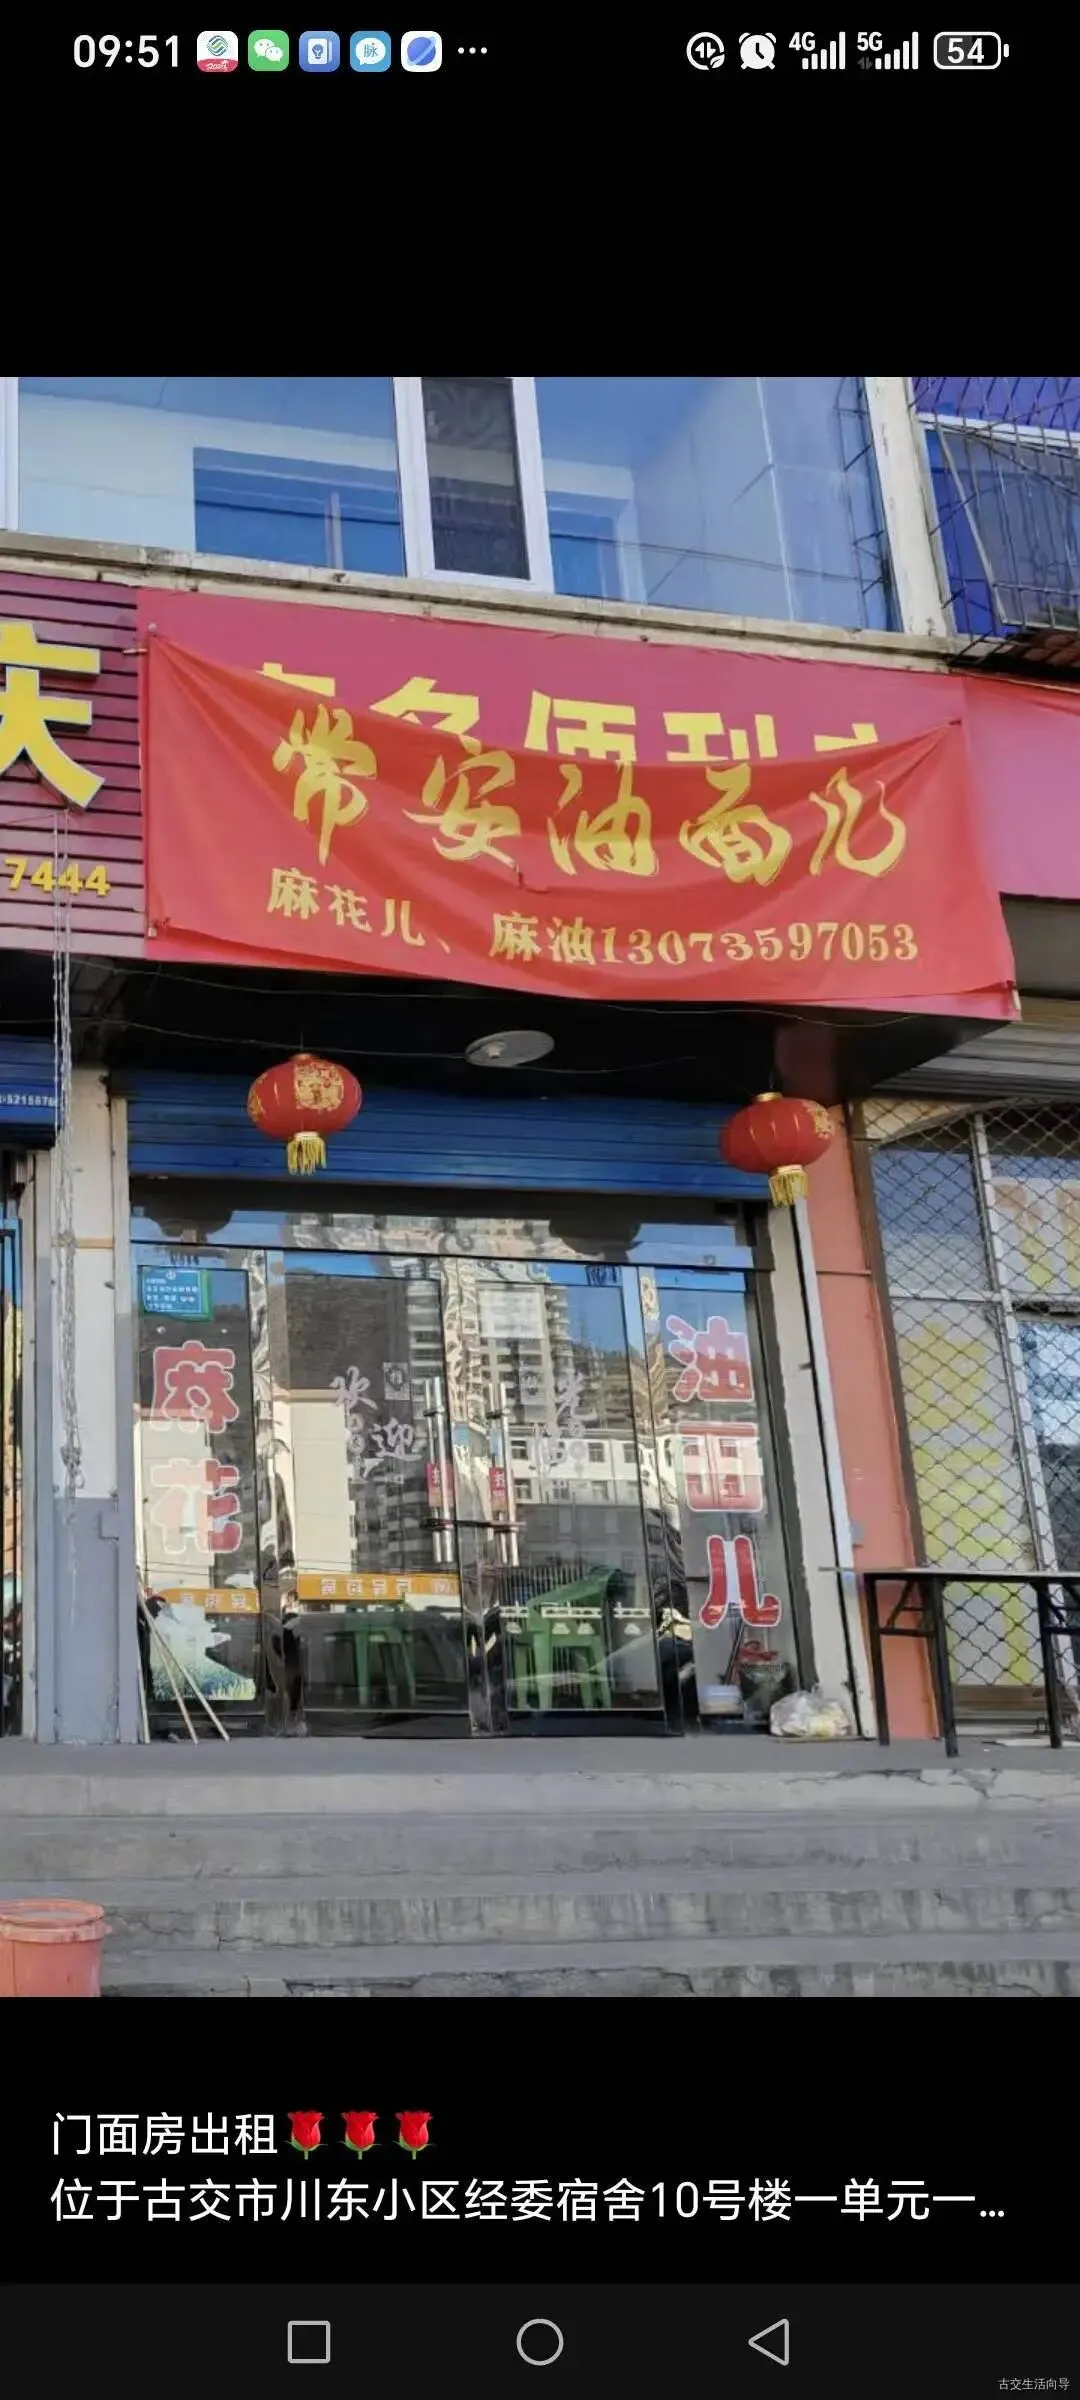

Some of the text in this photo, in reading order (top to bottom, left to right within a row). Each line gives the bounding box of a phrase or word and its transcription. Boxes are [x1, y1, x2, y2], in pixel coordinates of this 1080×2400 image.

[272, 704, 907, 886] 常安油面儿
[150, 1340, 244, 1555] 麻花
[665, 1315, 782, 1629] 油面儿
